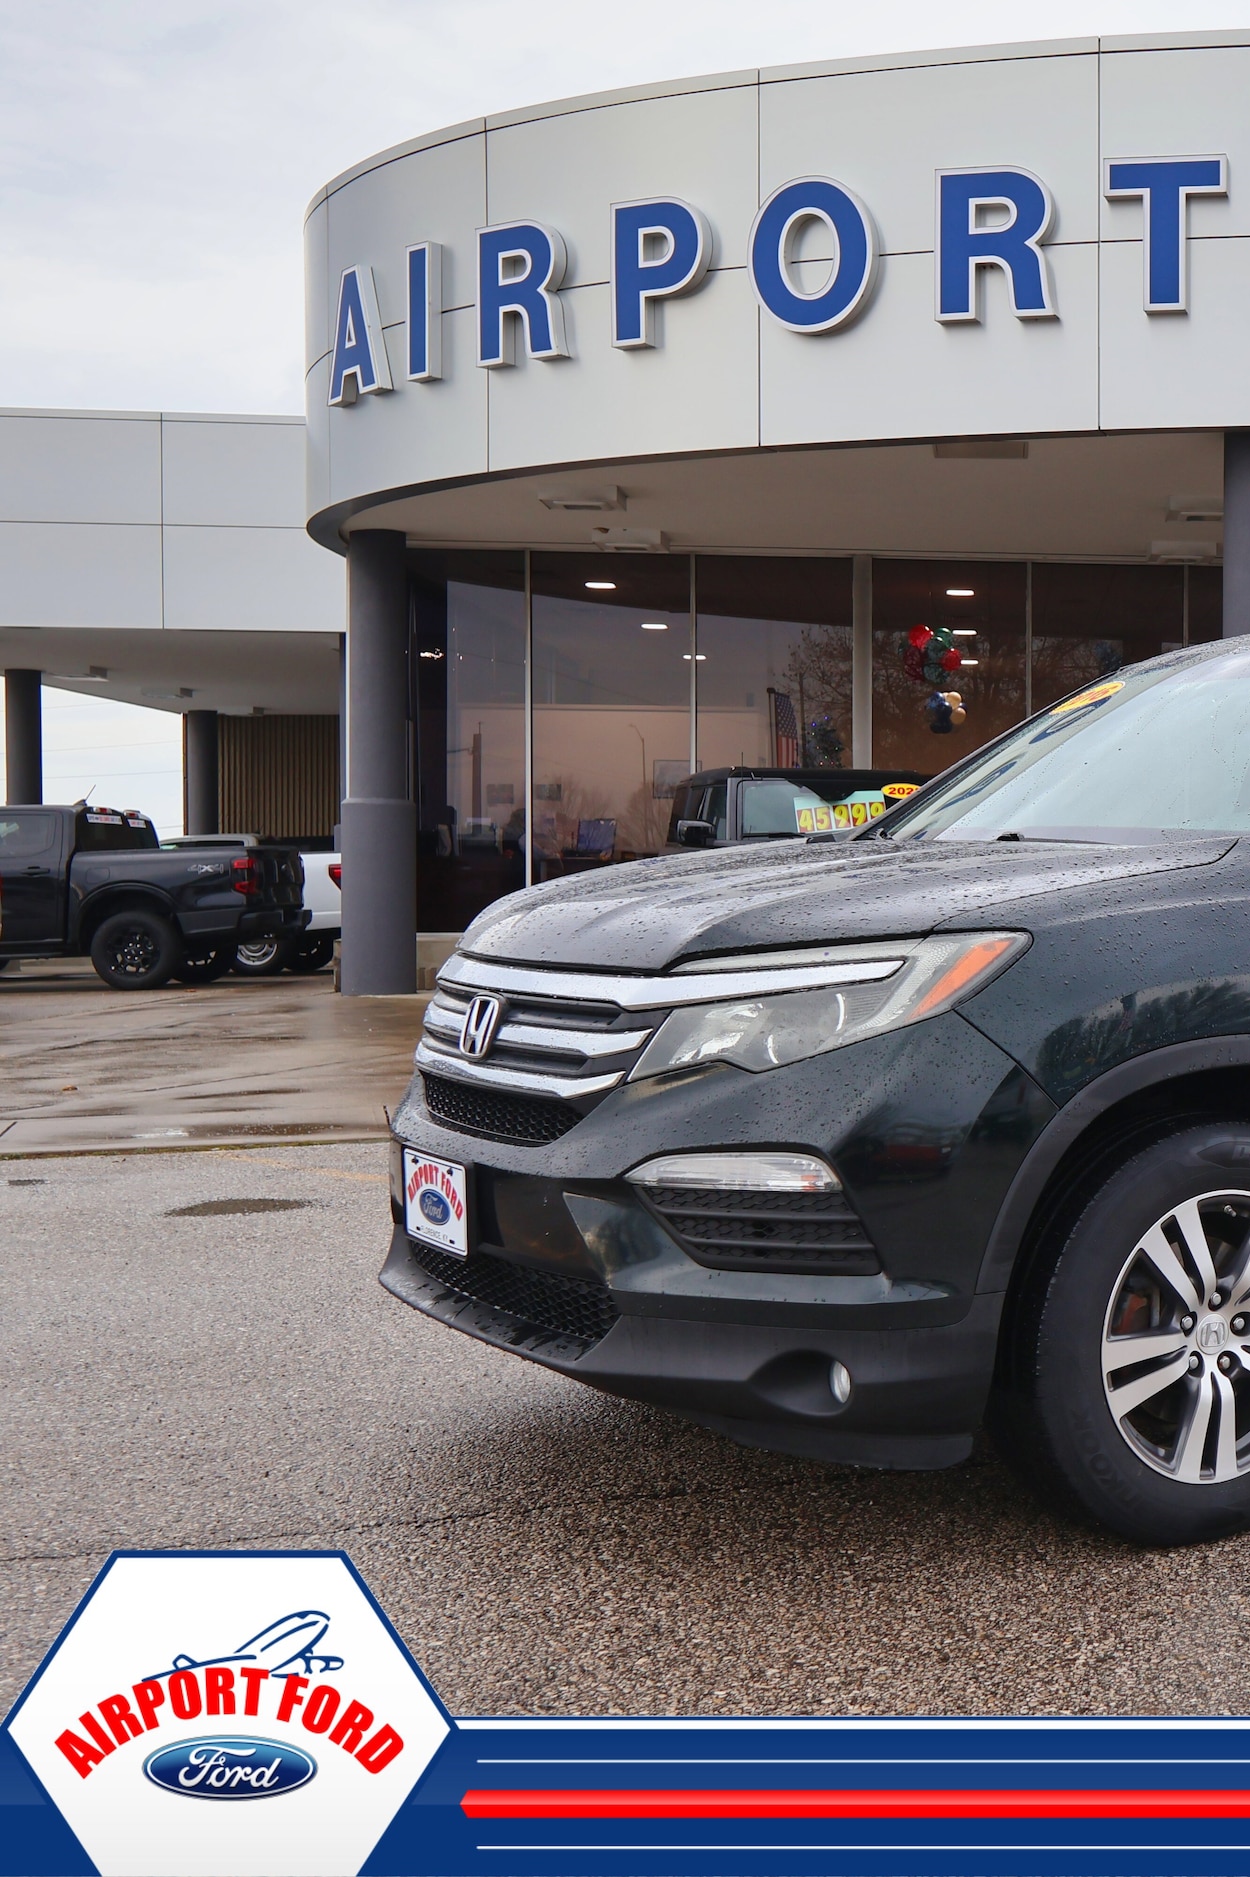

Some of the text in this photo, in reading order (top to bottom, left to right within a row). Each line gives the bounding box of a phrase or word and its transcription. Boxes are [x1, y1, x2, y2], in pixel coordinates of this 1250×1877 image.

[327, 153, 1229, 408] AIRPORT
[888, 787, 922, 796] 202
[407, 1164, 464, 1221] AIRPORT FORD
[424, 1193, 444, 1219] Ford
